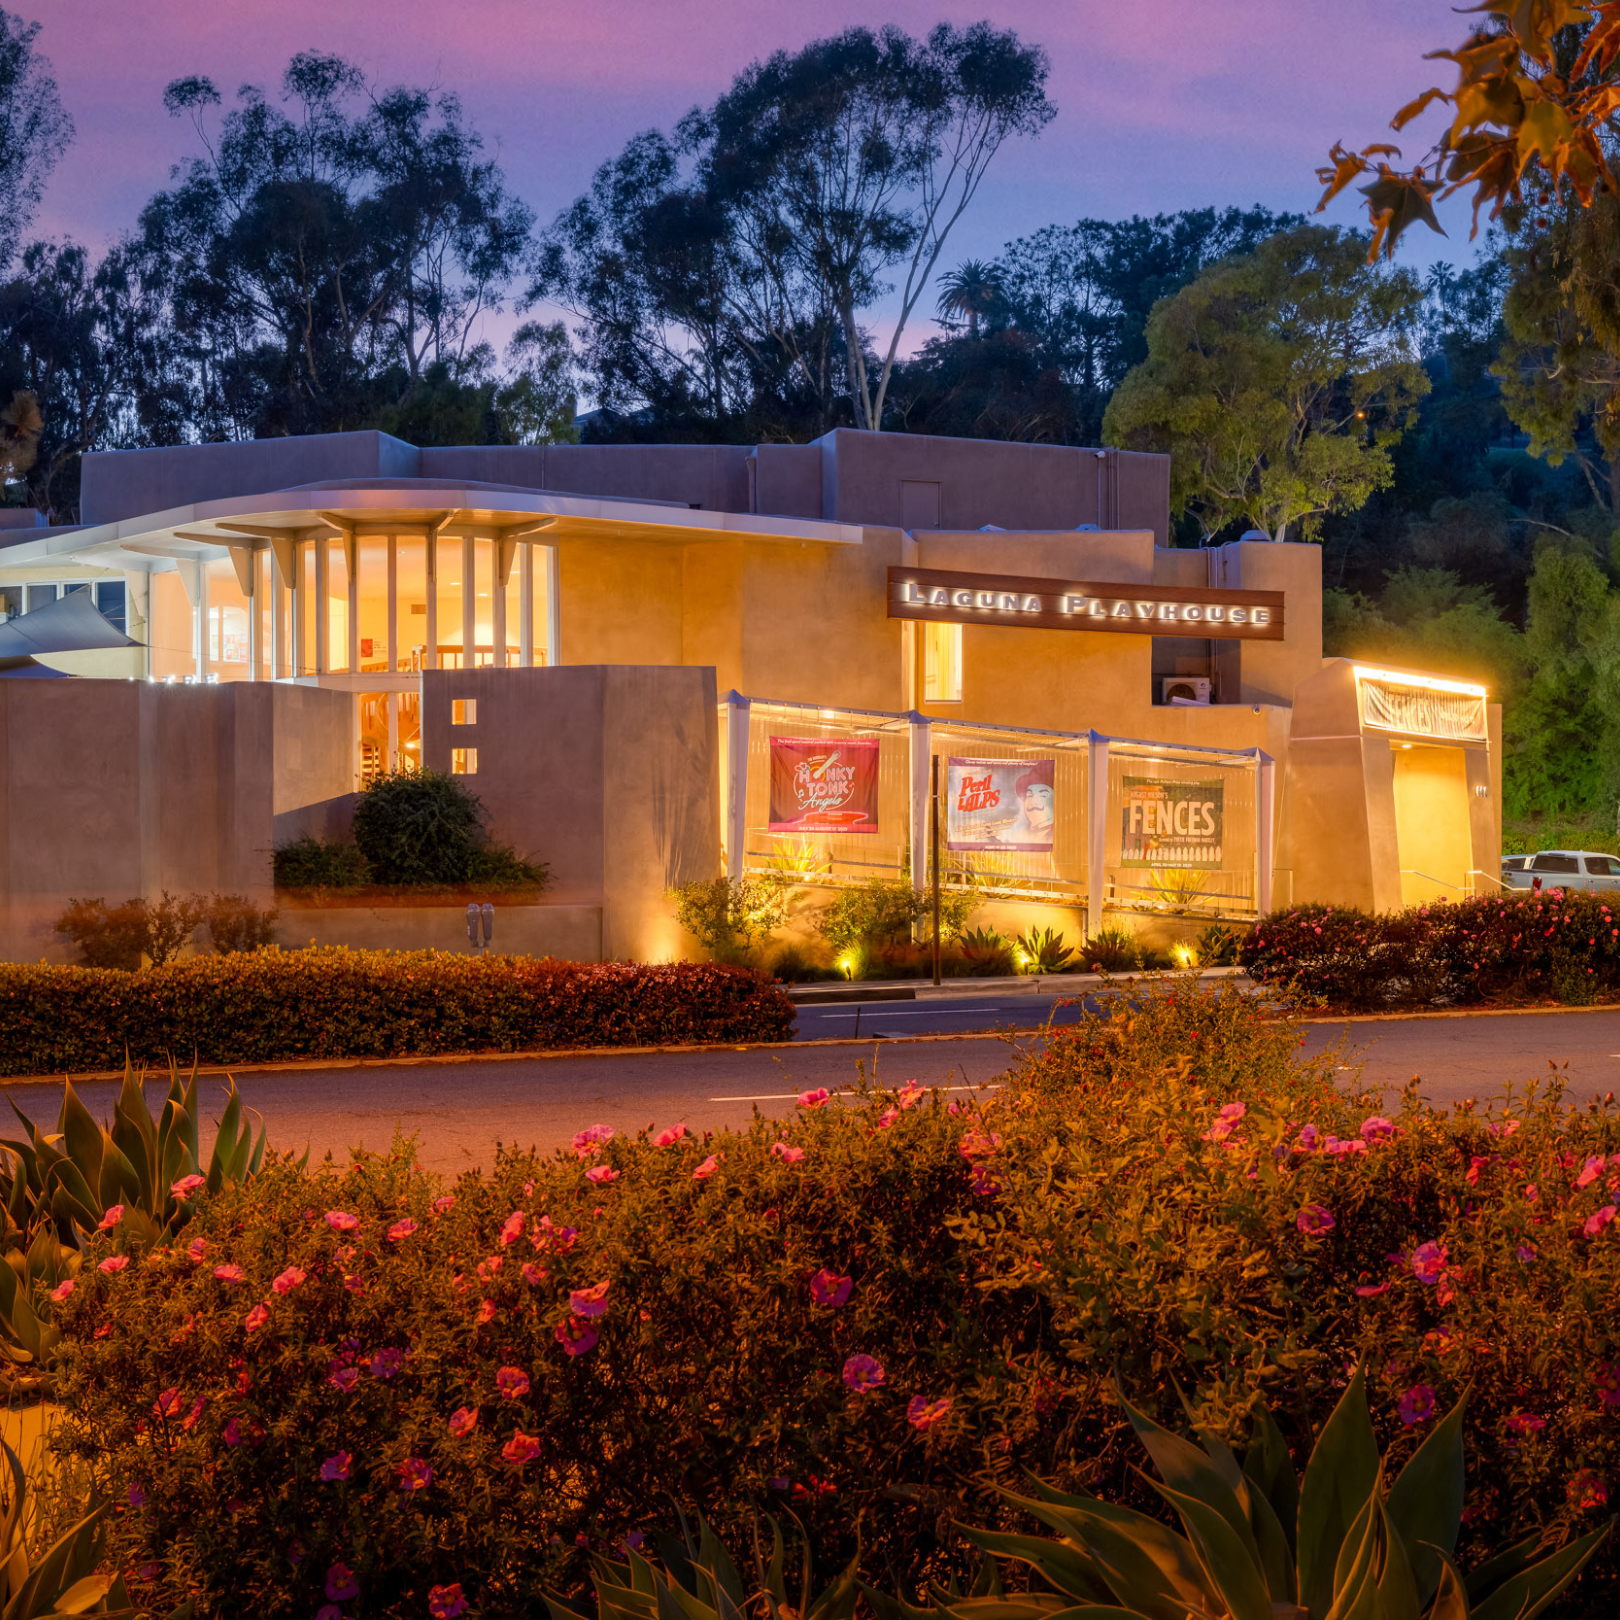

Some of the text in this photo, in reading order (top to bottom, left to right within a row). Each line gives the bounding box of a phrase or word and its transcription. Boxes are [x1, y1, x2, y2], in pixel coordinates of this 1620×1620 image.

[907, 583, 1270, 623] LAGUNA PLAYHOUSE
[799, 766, 856, 783] HONKY
[959, 774, 993, 797] Peril
[806, 780, 849, 797] TONK
[963, 789, 1001, 812] ALPS
[1129, 799, 1215, 836] FENCES
